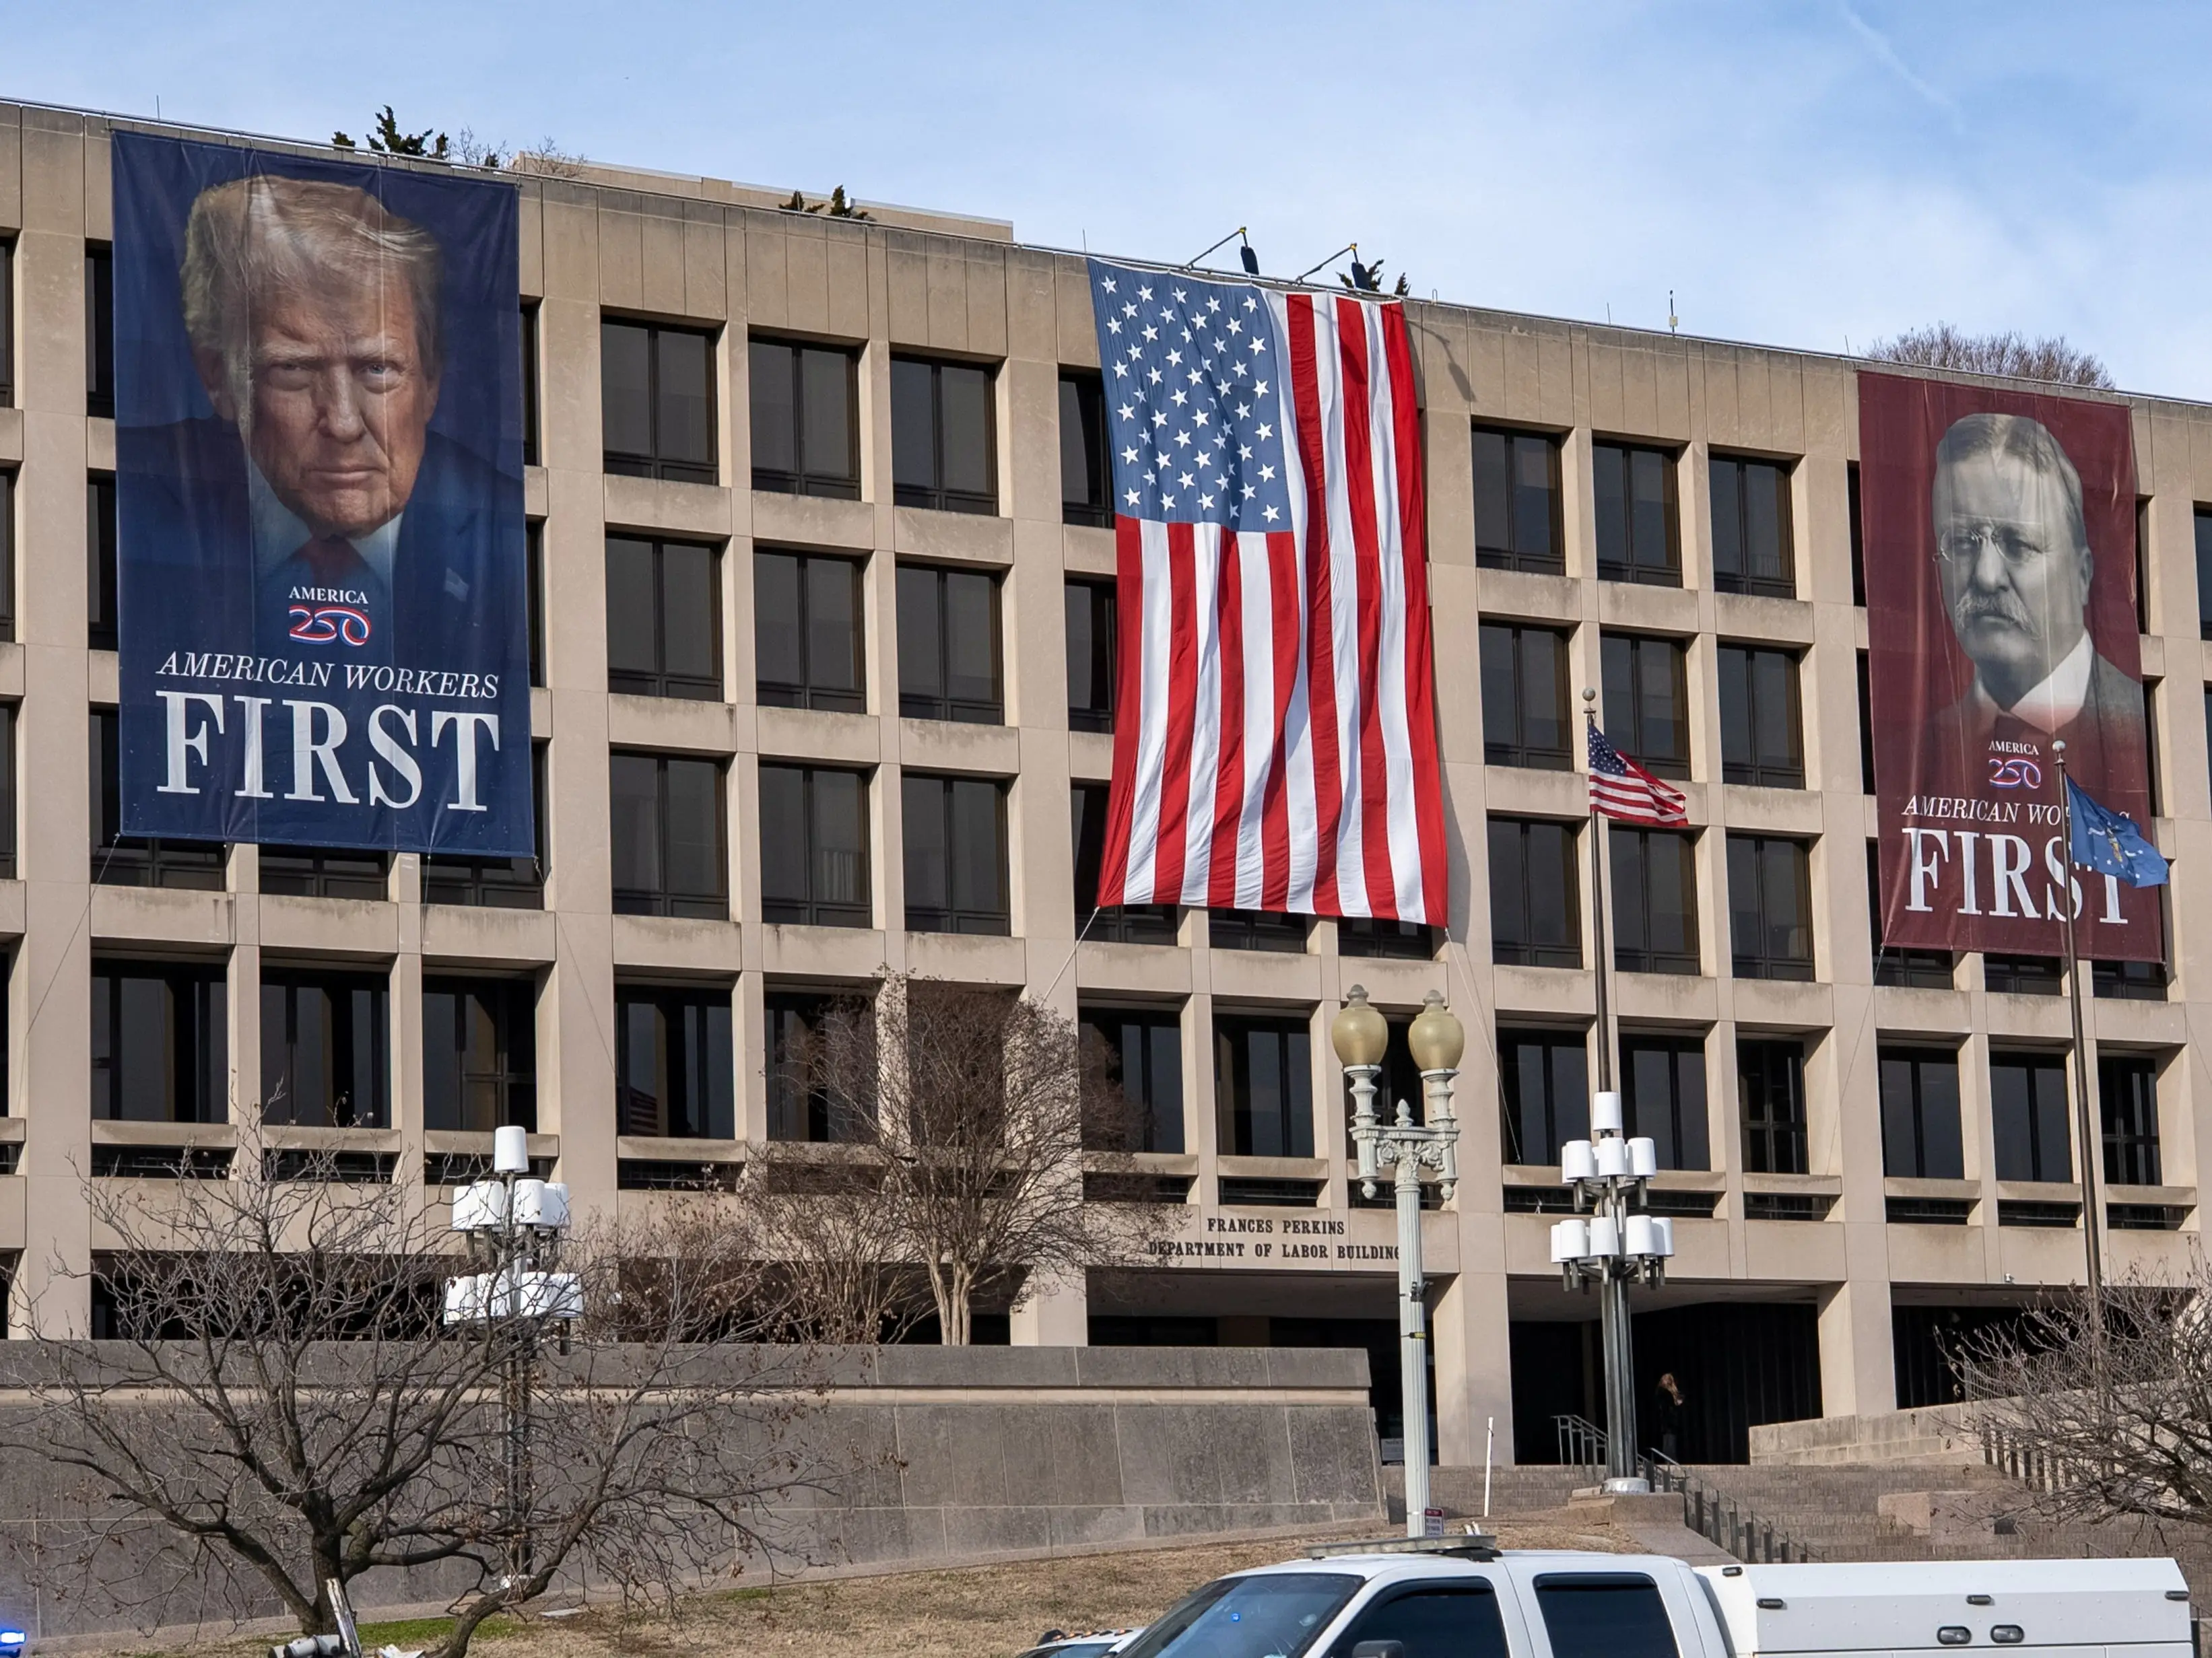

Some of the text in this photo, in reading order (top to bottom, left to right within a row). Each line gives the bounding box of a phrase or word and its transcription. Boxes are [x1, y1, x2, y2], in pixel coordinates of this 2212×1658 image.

[288, 586, 369, 605] AMERICA
[289, 605, 372, 647] 250
[156, 651, 498, 698] AMERICAN WORKERS
[156, 691, 499, 812] FIRST
[1988, 740, 2040, 755] AMERICA
[1988, 757, 2041, 789] 250
[1902, 795, 2021, 823] AMERICAN
[1207, 1218, 1345, 1235] FRANCES PERKINS
[1148, 1241, 1245, 1257] DEPARTMENT
[1254, 1243, 1272, 1257] OF
[1282, 1243, 1329, 1259] LABOR
